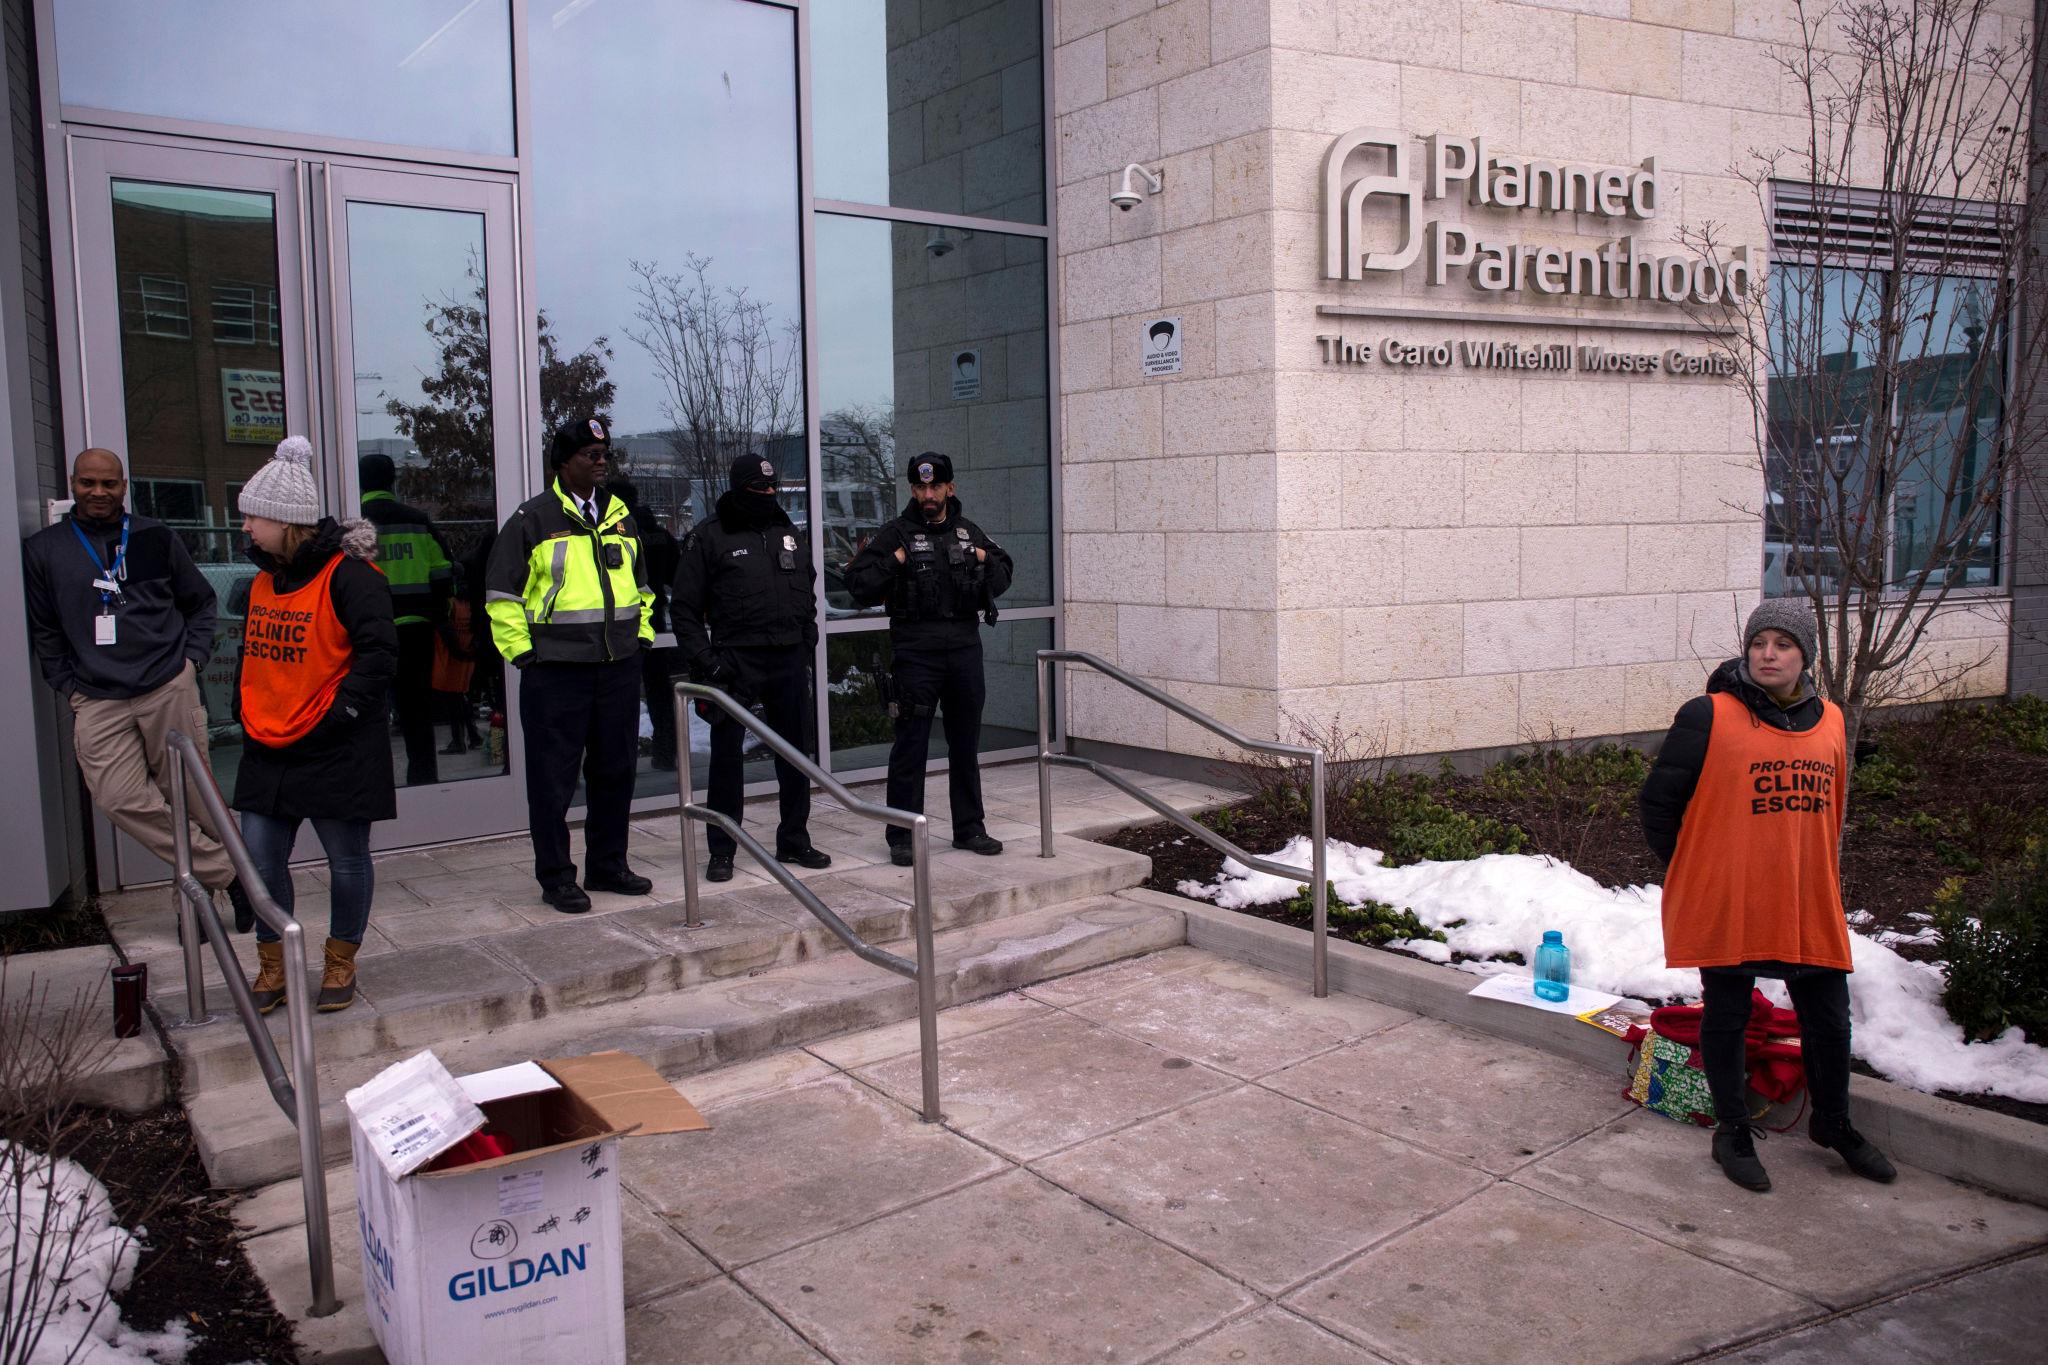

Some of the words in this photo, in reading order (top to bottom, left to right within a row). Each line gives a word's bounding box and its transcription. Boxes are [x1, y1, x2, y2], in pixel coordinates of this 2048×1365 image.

[1428, 134, 1661, 220] Planned
[1428, 220, 1754, 305] Parenthood
[1145, 358, 1174, 367] SURVEILLANCE
[1317, 335, 1376, 363] The
[1381, 337, 1455, 365] Carol
[1460, 340, 1571, 370] Whitehill
[1579, 345, 1660, 373] Moses
[249, 620, 306, 643] CLINIC
[244, 641, 308, 663] ESCORT
[1749, 760, 1836, 777] PRO-CHOICE
[1754, 773, 1831, 796] CLINIC
[484, 1295, 559, 1319] www.mygildan.com
